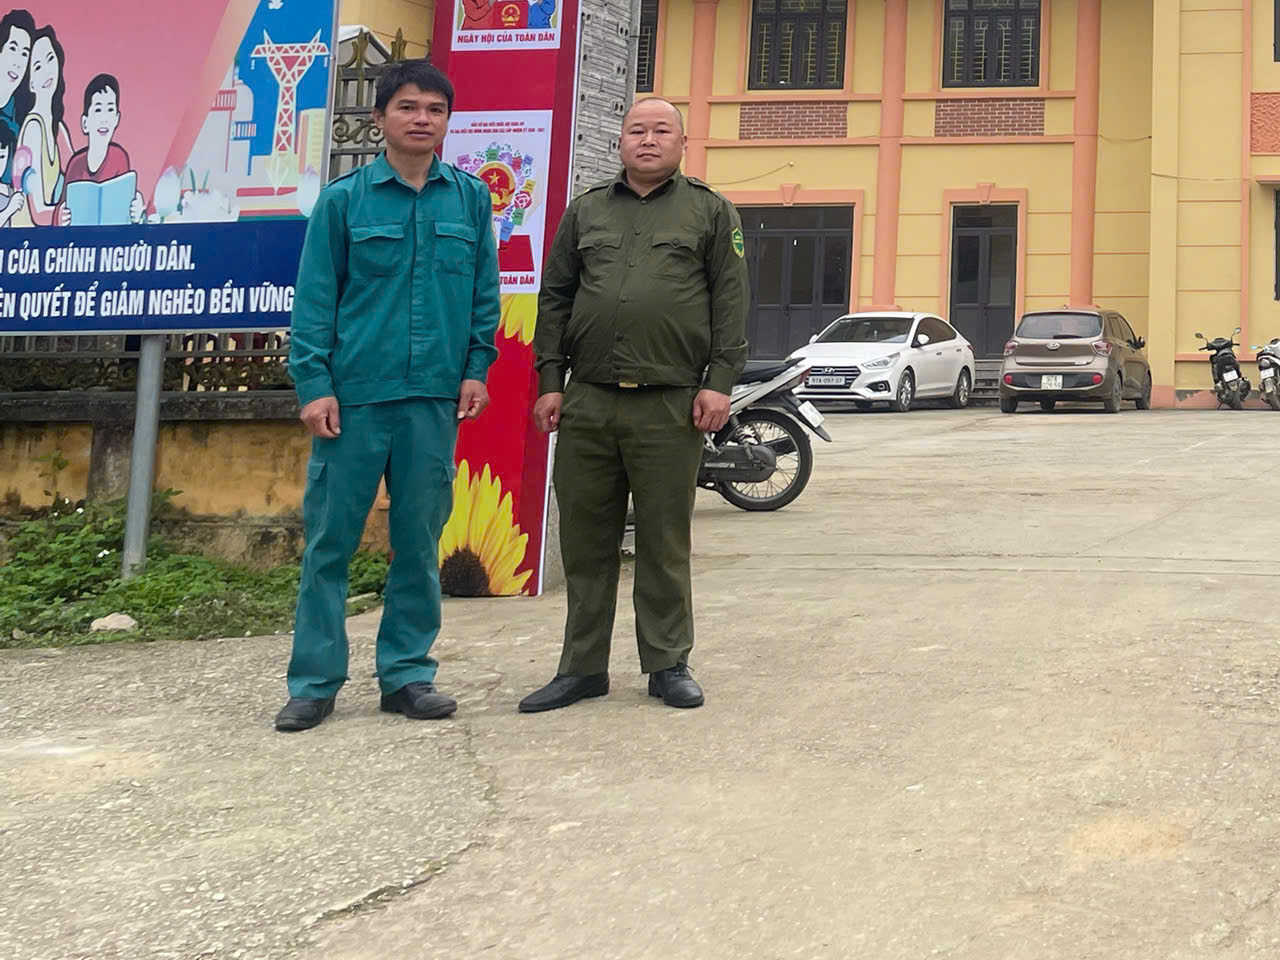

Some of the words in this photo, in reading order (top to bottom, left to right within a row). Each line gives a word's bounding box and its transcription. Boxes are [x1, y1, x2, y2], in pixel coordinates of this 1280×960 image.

[457, 33, 479, 43] NGÀY
[481, 32, 494, 44] HỘI
[496, 31, 513, 43] CỦA
[515, 32, 536, 42] TOÀN
[538, 31, 555, 42] DÂN
[7, 240, 40, 274] CỦA
[44, 242, 97, 273] CHÍNH
[99, 239, 152, 272] NGƯỜI
[154, 239, 196, 271] DÂN.
[519, 274, 535, 285] DÂN
[19, 283, 71, 321] QUYẾT
[74, 280, 99, 317] ĐỂ
[100, 281, 145, 317] GIẢM
[147, 283, 206, 316] NGHÈO
[209, 279, 245, 314] BỀN
[249, 281, 295, 313] VỮNG
